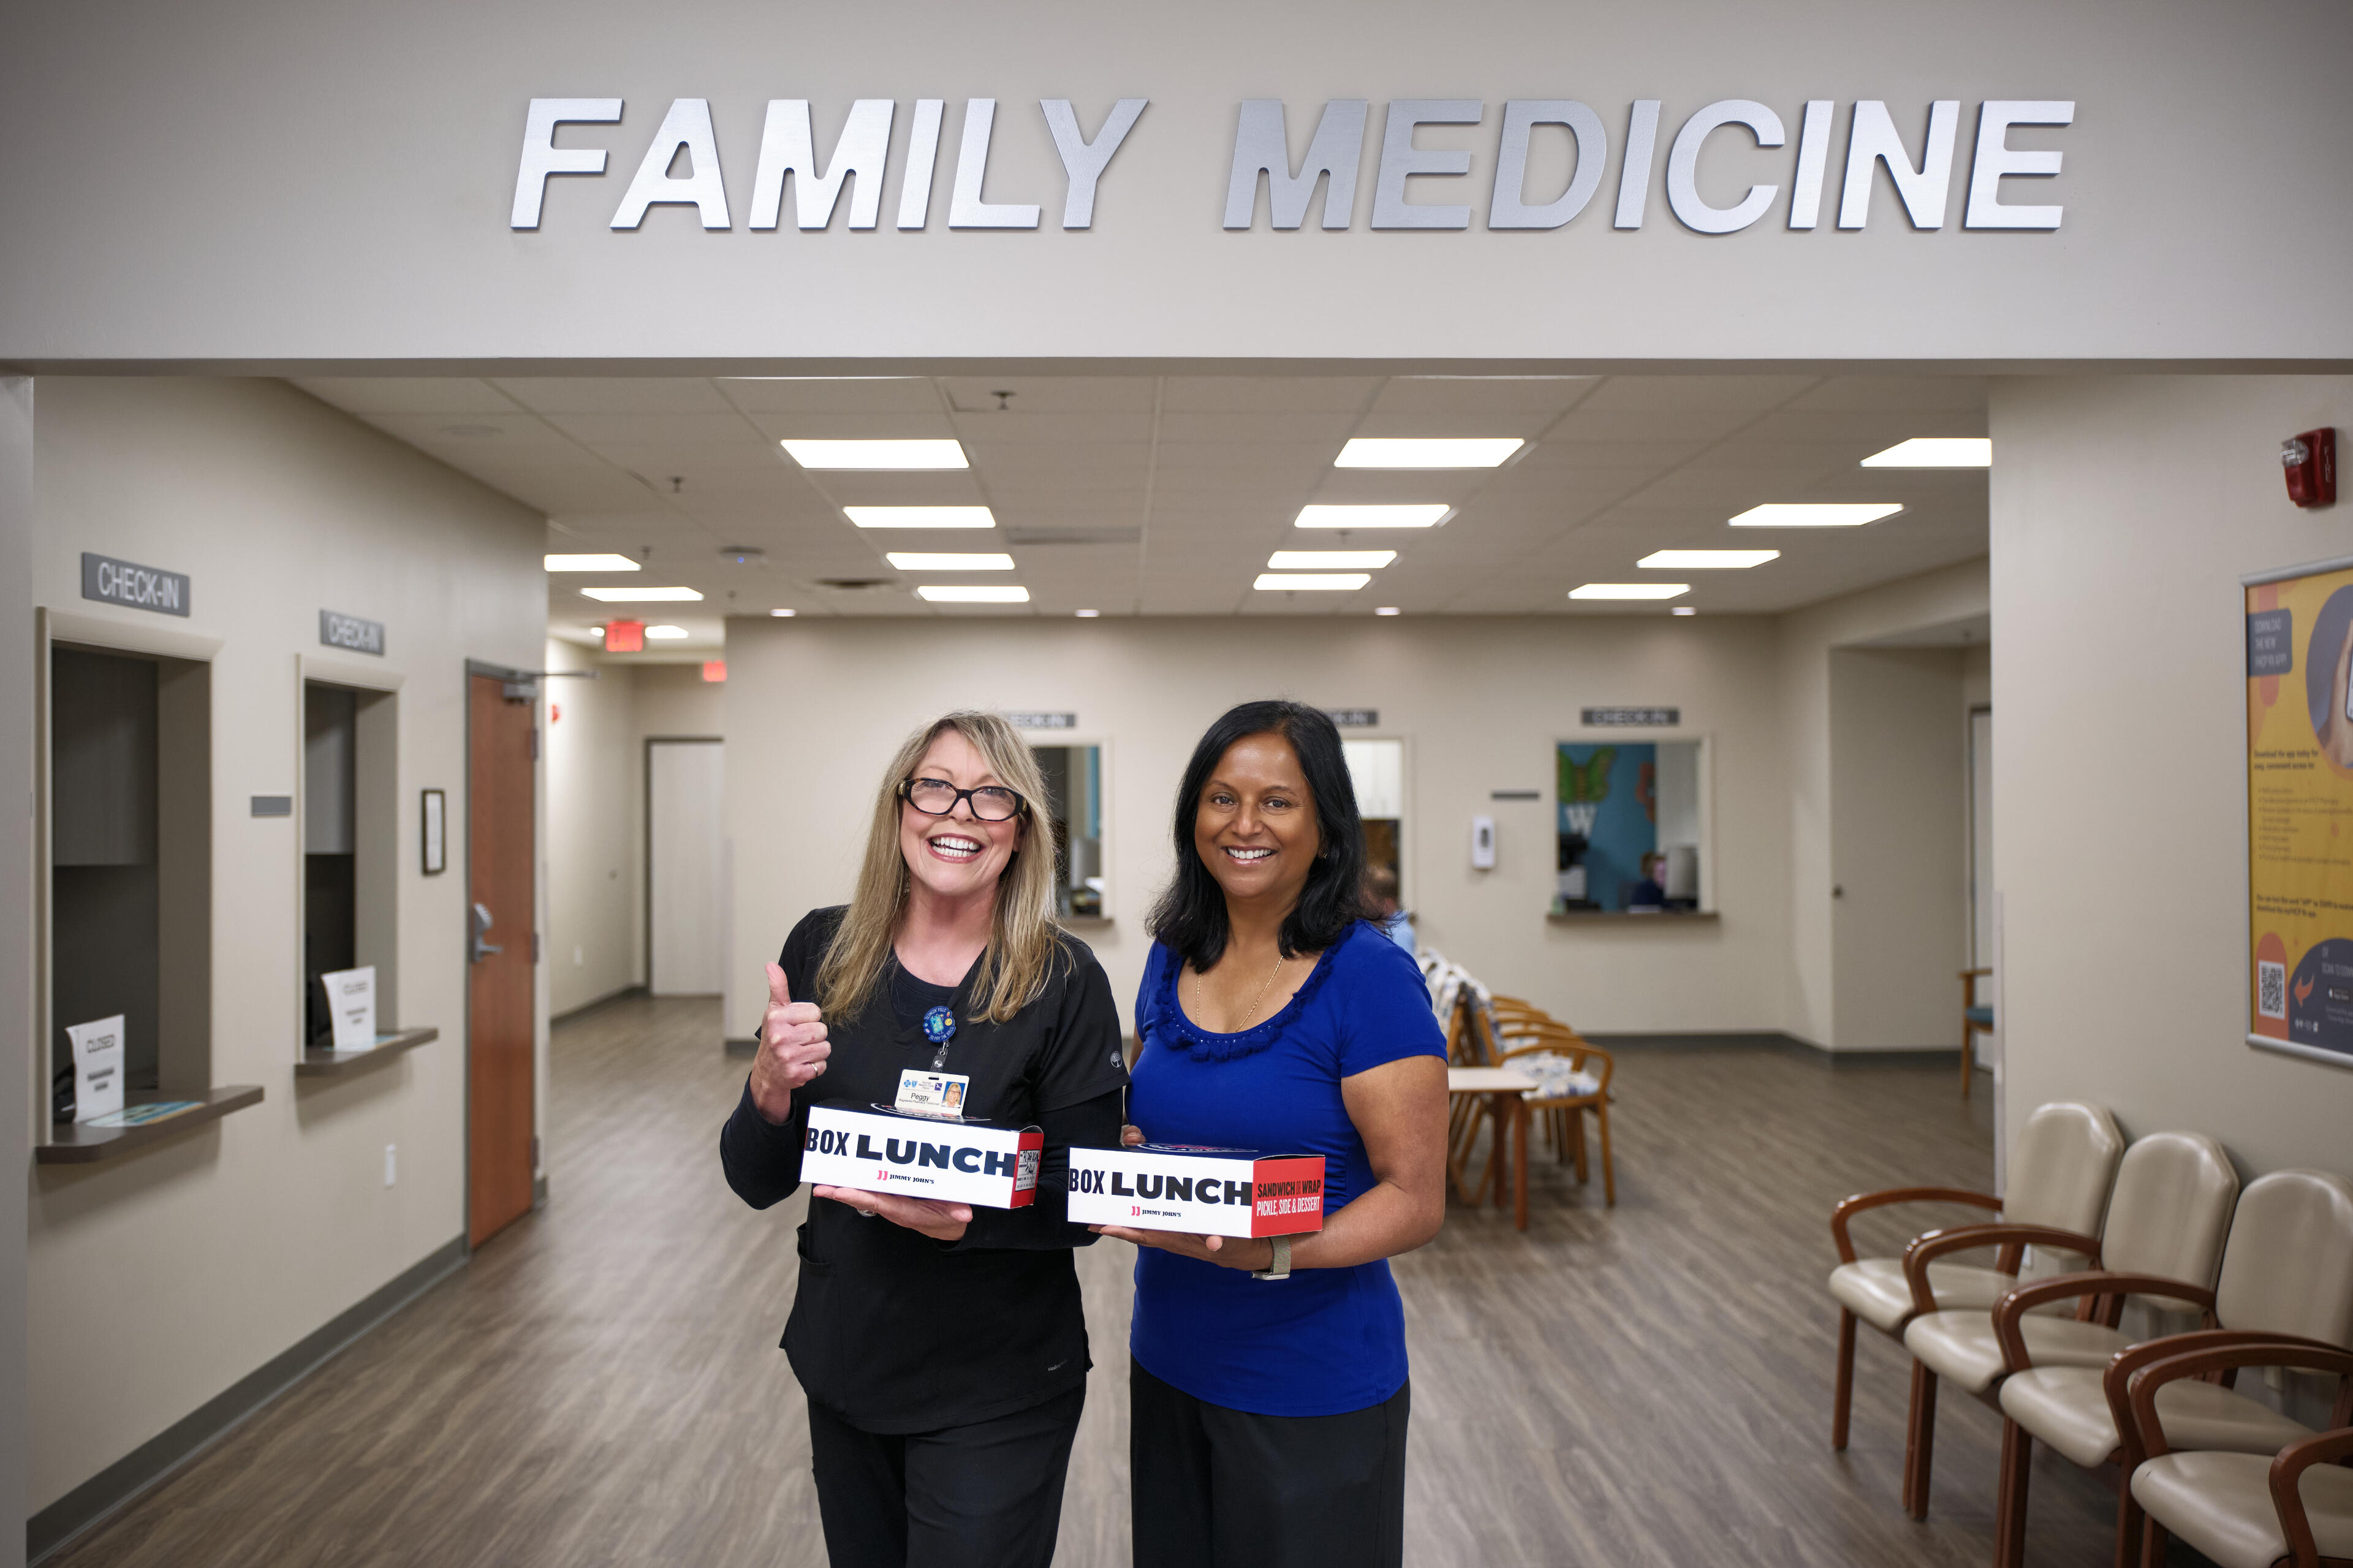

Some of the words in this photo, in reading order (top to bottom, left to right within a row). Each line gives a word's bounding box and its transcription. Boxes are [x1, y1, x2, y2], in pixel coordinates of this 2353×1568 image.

[510, 98, 1150, 230] FAMILY
[1223, 99, 2075, 234] MEDICINE
[97, 561, 180, 610] CHECK-IN
[328, 615, 379, 651] CHECK-IN
[911, 1093, 930, 1102] Peggy
[805, 1127, 851, 1156] BOX
[855, 1134, 1017, 1178] LUNCH
[1069, 1168, 1105, 1195] BOX
[1111, 1172, 1253, 1206] LUNCH
[1257, 1181, 1295, 1198] SANDWICH
[1296, 1181, 1301, 1195] OR
[1302, 1180, 1321, 1194] WRAP
[1257, 1200, 1278, 1217] PICKLE,
[1279, 1199, 1291, 1214] SIDE
[1292, 1198, 1297, 1213] &
[1297, 1195, 1320, 1213] DESSERT
